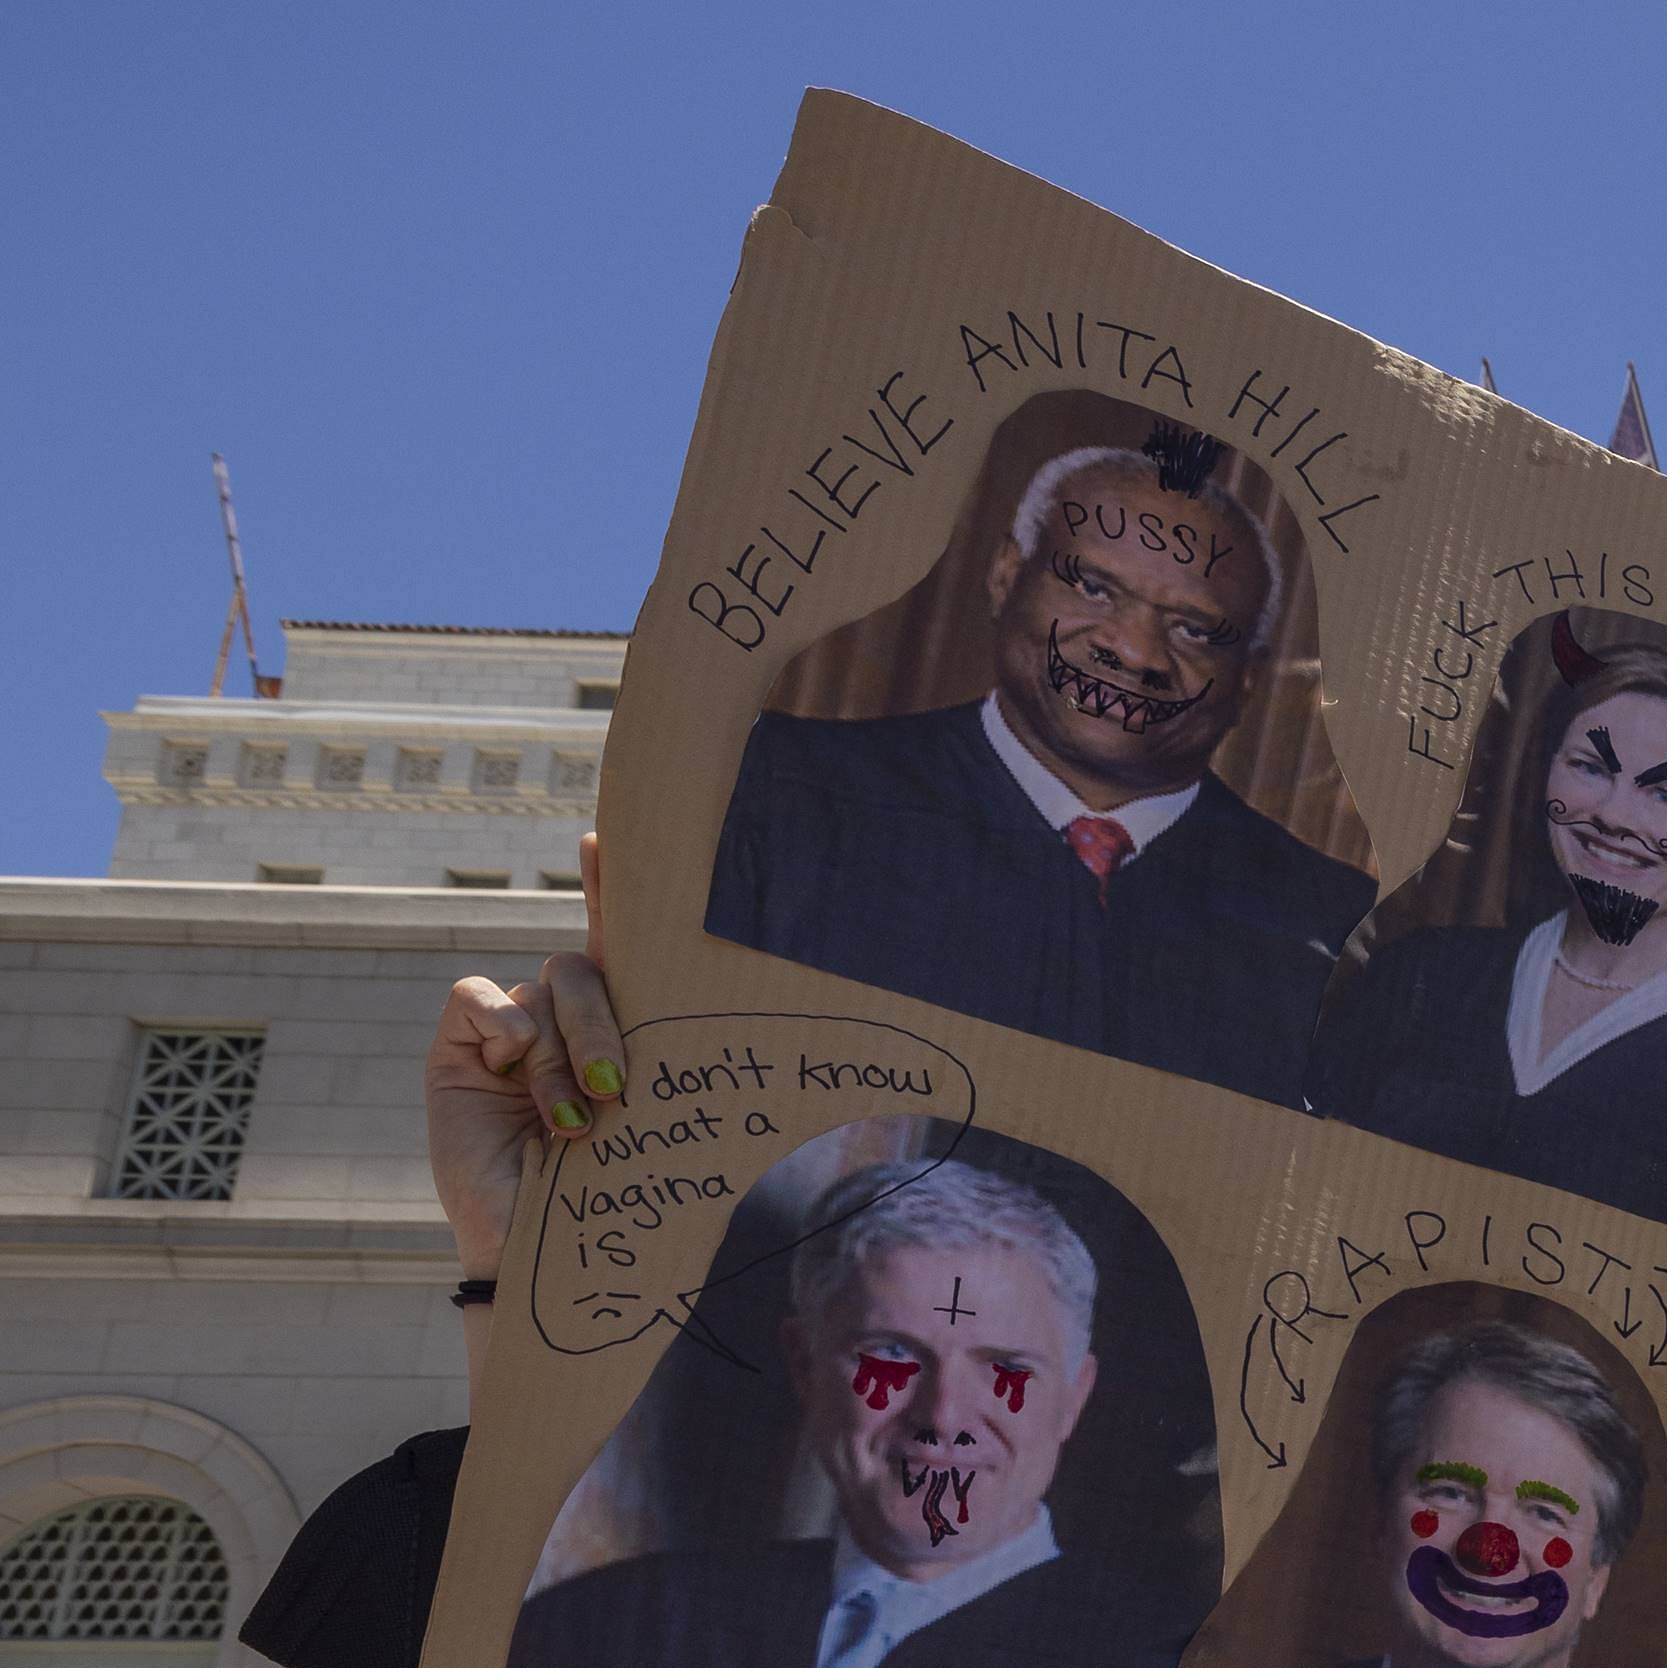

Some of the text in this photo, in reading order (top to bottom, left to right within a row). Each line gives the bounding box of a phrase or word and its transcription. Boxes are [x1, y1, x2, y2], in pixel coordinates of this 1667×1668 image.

[688, 311, 1381, 653] BELIEVE ANITA HILL
[1062, 500, 1235, 580] PUSSY
[1409, 600, 1498, 769] FUCK
[1493, 549, 1653, 608] THIS
[652, 1047, 774, 1103] don't
[798, 1053, 934, 1098] know
[591, 1108, 781, 1170] what a
[560, 1170, 736, 1231] vagina
[1262, 1210, 1632, 1344] RAPIST
